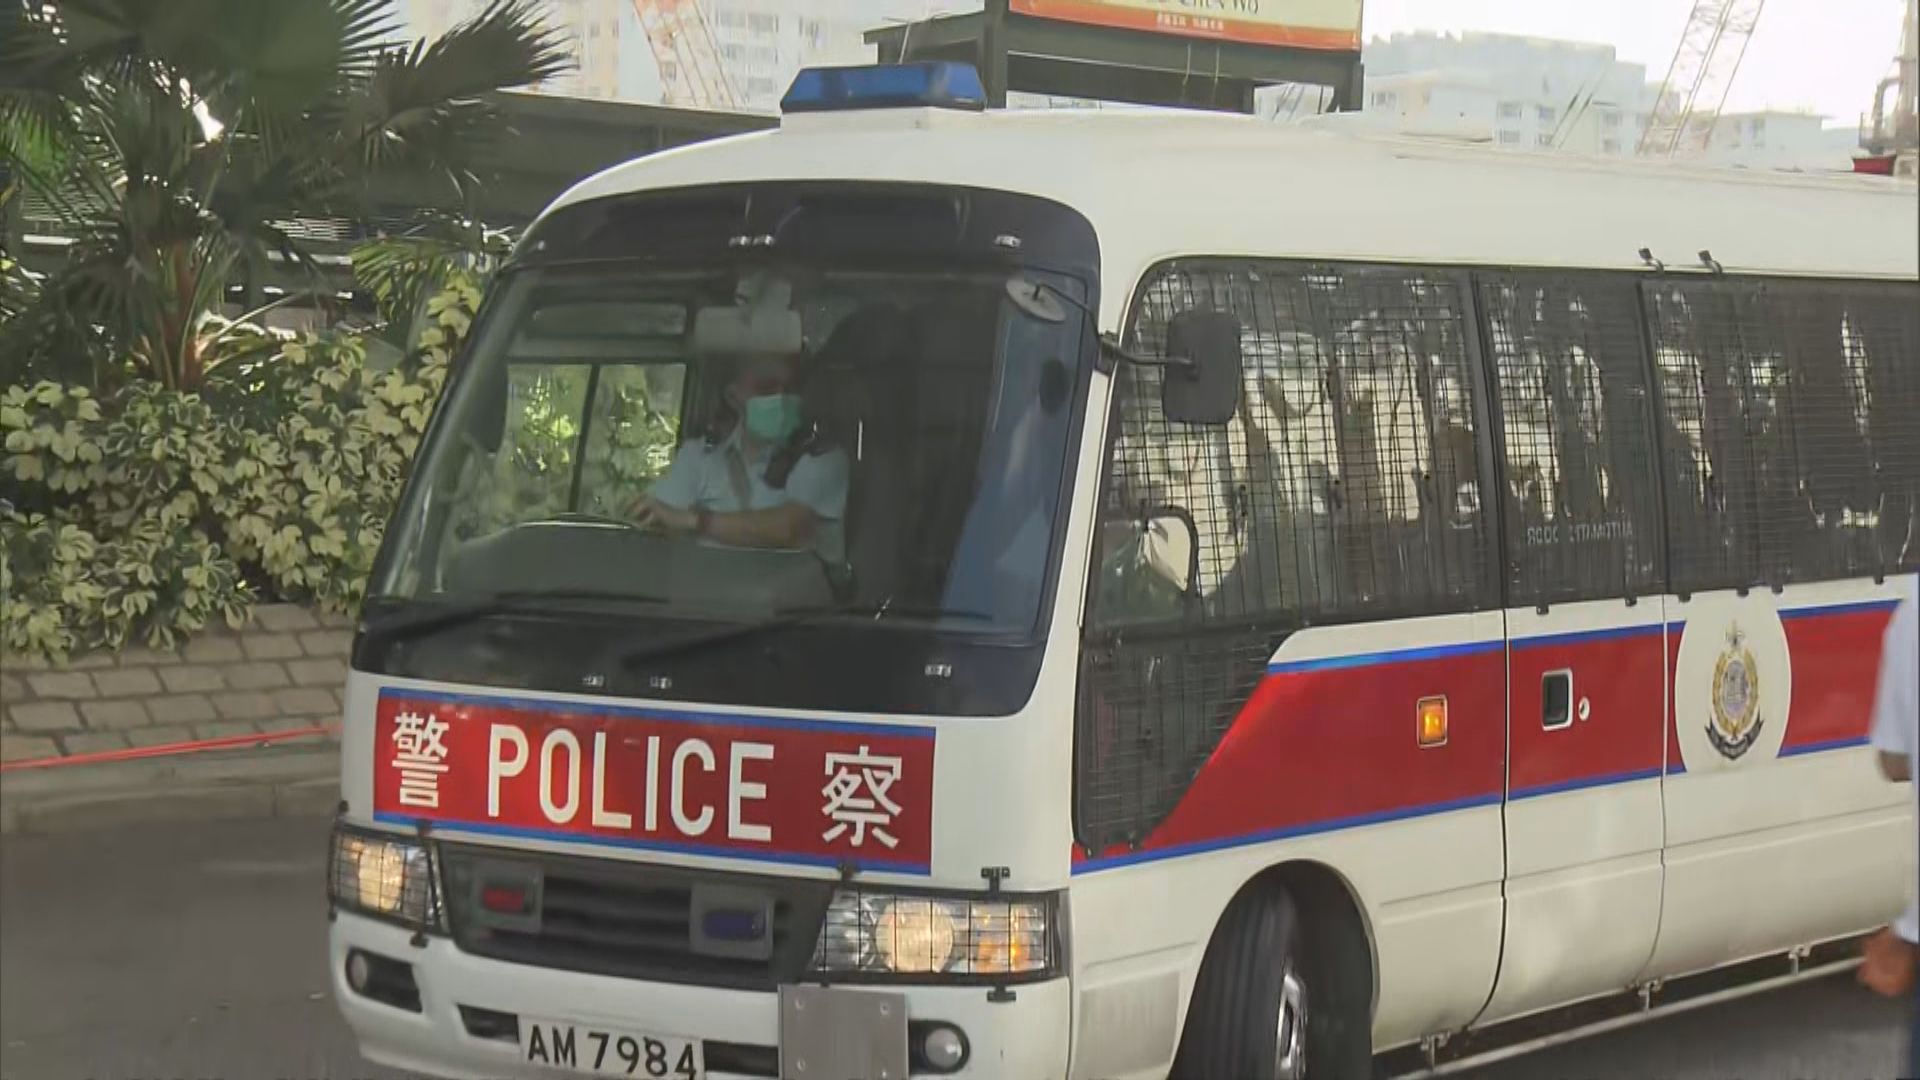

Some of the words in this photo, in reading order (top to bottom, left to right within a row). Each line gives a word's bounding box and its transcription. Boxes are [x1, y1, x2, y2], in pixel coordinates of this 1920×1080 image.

[391, 712, 449, 808] 警
[487, 723, 775, 843] POLICE
[821, 745, 903, 849] 察
[527, 1024, 577, 1068] AM
[588, 1031, 697, 1080] 7984
